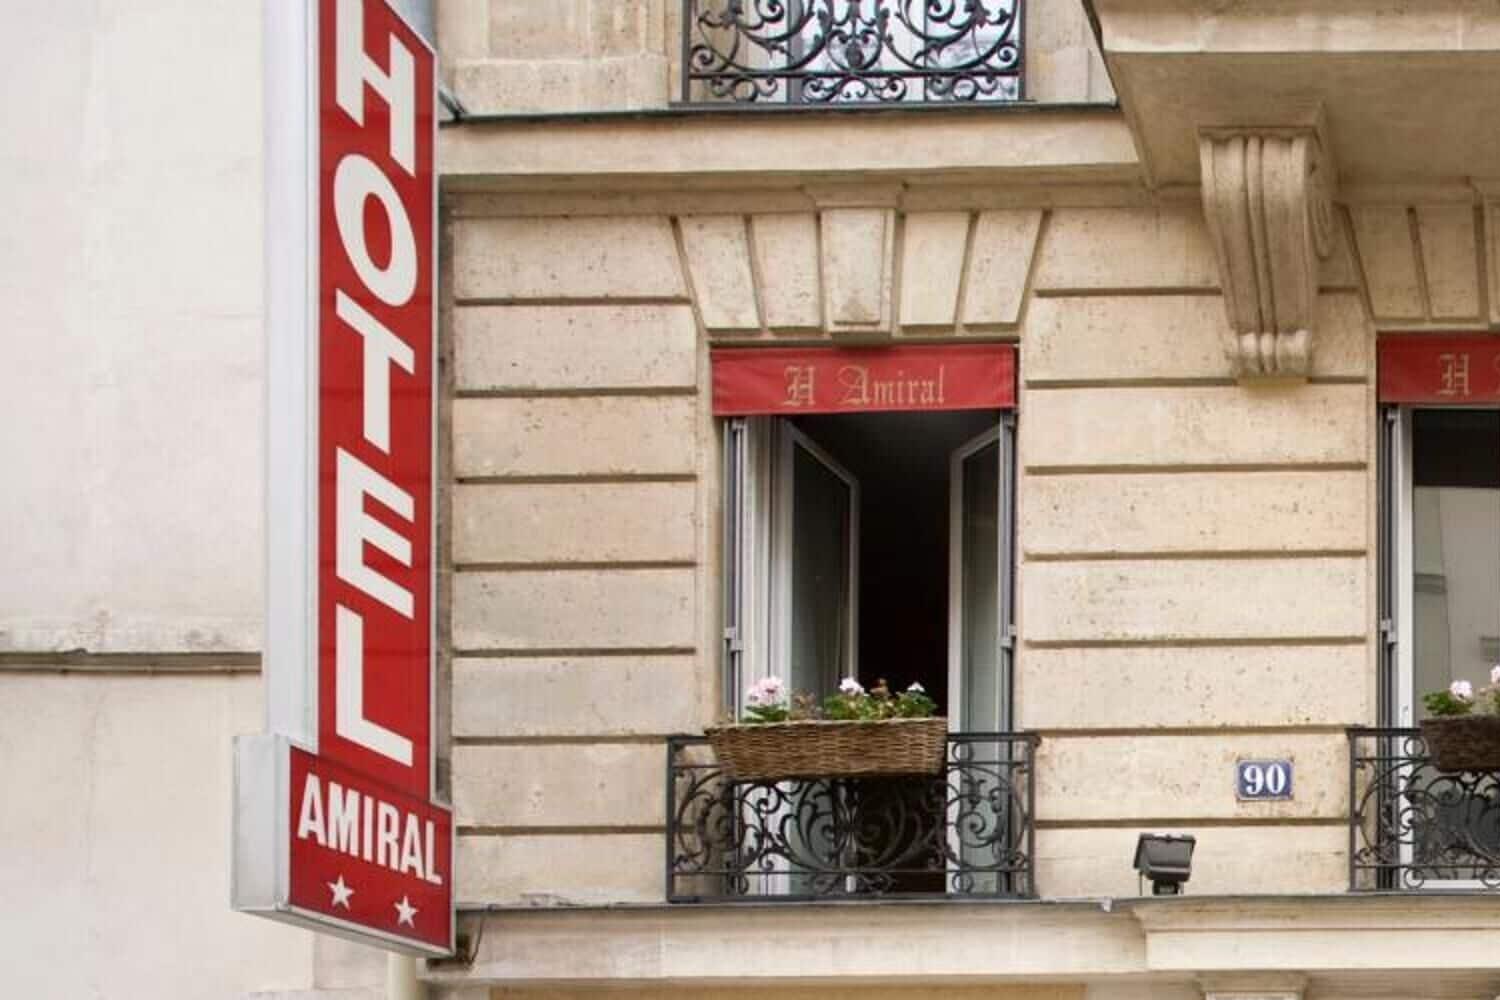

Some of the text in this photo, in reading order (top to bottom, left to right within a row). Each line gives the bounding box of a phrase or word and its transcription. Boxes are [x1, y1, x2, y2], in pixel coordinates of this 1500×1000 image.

[333, 0, 418, 767] HOTEL
[837, 364, 946, 407] Amiral
[1242, 762, 1286, 795] 90
[297, 772, 443, 886] AMIRAL
